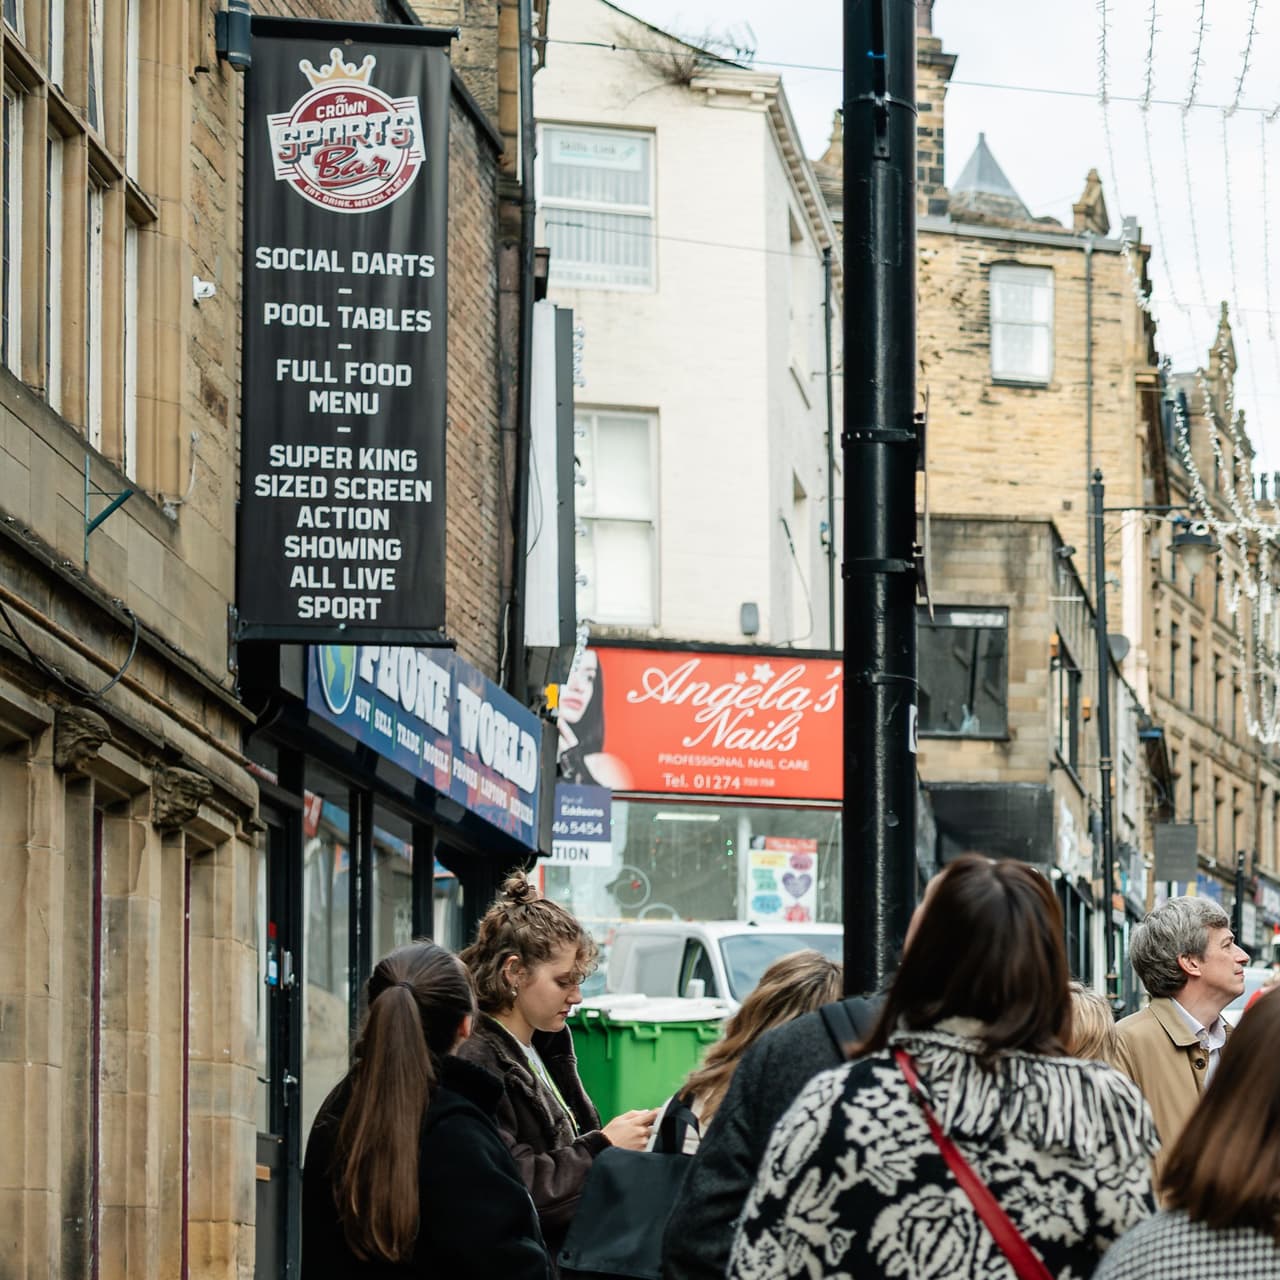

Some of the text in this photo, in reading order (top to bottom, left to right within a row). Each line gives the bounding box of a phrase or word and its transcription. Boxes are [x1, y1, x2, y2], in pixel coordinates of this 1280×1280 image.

[316, 100, 368, 118] CROWN
[278, 112, 414, 164] SPORTS
[314, 144, 391, 182] Bar
[256, 247, 435, 278] SOCIAL DARTS
[264, 303, 431, 332] POOL TABLES
[276, 359, 412, 388] FULL FOOD
[308, 390, 379, 415] MENU
[270, 445, 417, 472] SUPER KING
[254, 474, 432, 503] SIZED SCREEN
[296, 506, 390, 531] ACTION
[284, 535, 402, 562] SHOWING
[290, 566, 396, 592] ALL LIVE
[298, 596, 381, 620] SPORT
[626, 658, 842, 723] Angela's
[355, 695, 371, 722] BUY
[374, 708, 392, 738] SELL
[359, 645, 538, 794] PHONE WORLD
[682, 708, 804, 752] Nails
[658, 754, 810, 771] PROFESSIONAL NAIL CARE
[662, 772, 688, 788] Tel.
[694, 774, 741, 790] 01274
